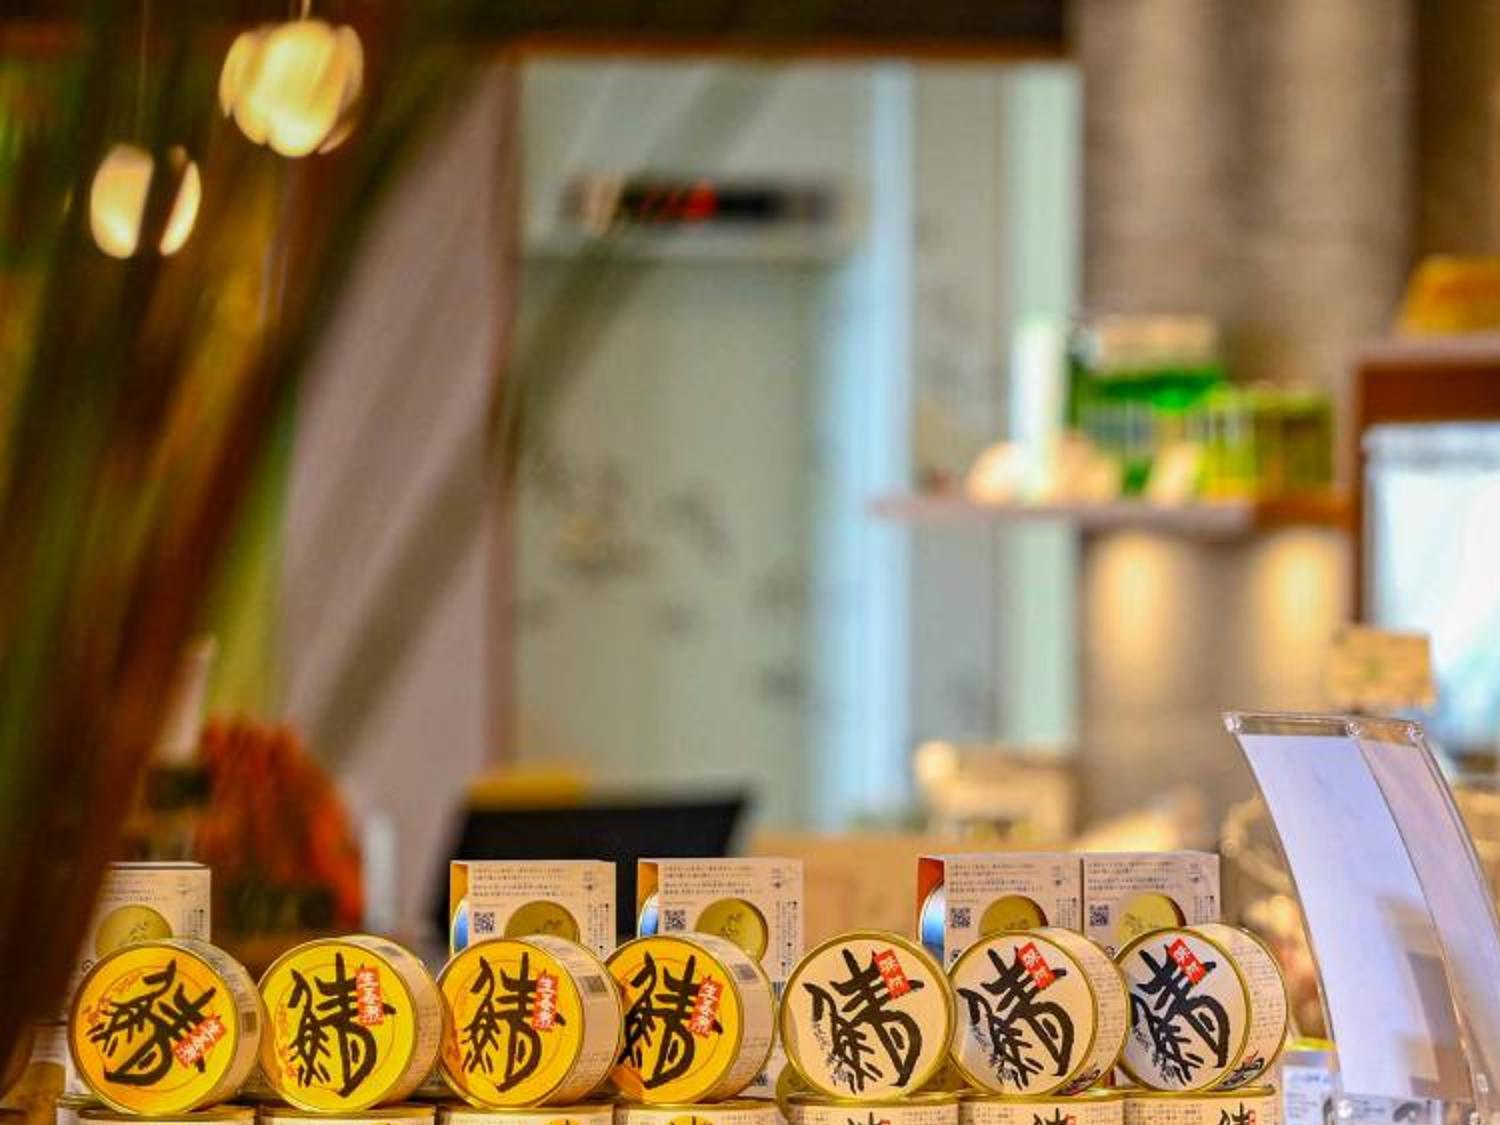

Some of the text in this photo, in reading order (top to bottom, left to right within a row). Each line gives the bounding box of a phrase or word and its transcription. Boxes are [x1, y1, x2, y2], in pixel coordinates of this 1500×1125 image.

[87, 959, 216, 1086] 鯖
[288, 952, 396, 1098] 鯖
[462, 952, 566, 1093] 鯖
[617, 951, 723, 1089] 鯖
[803, 948, 924, 1094] 鯖
[957, 946, 1067, 1091] 鯖
[1130, 944, 1216, 1086] 鯖
